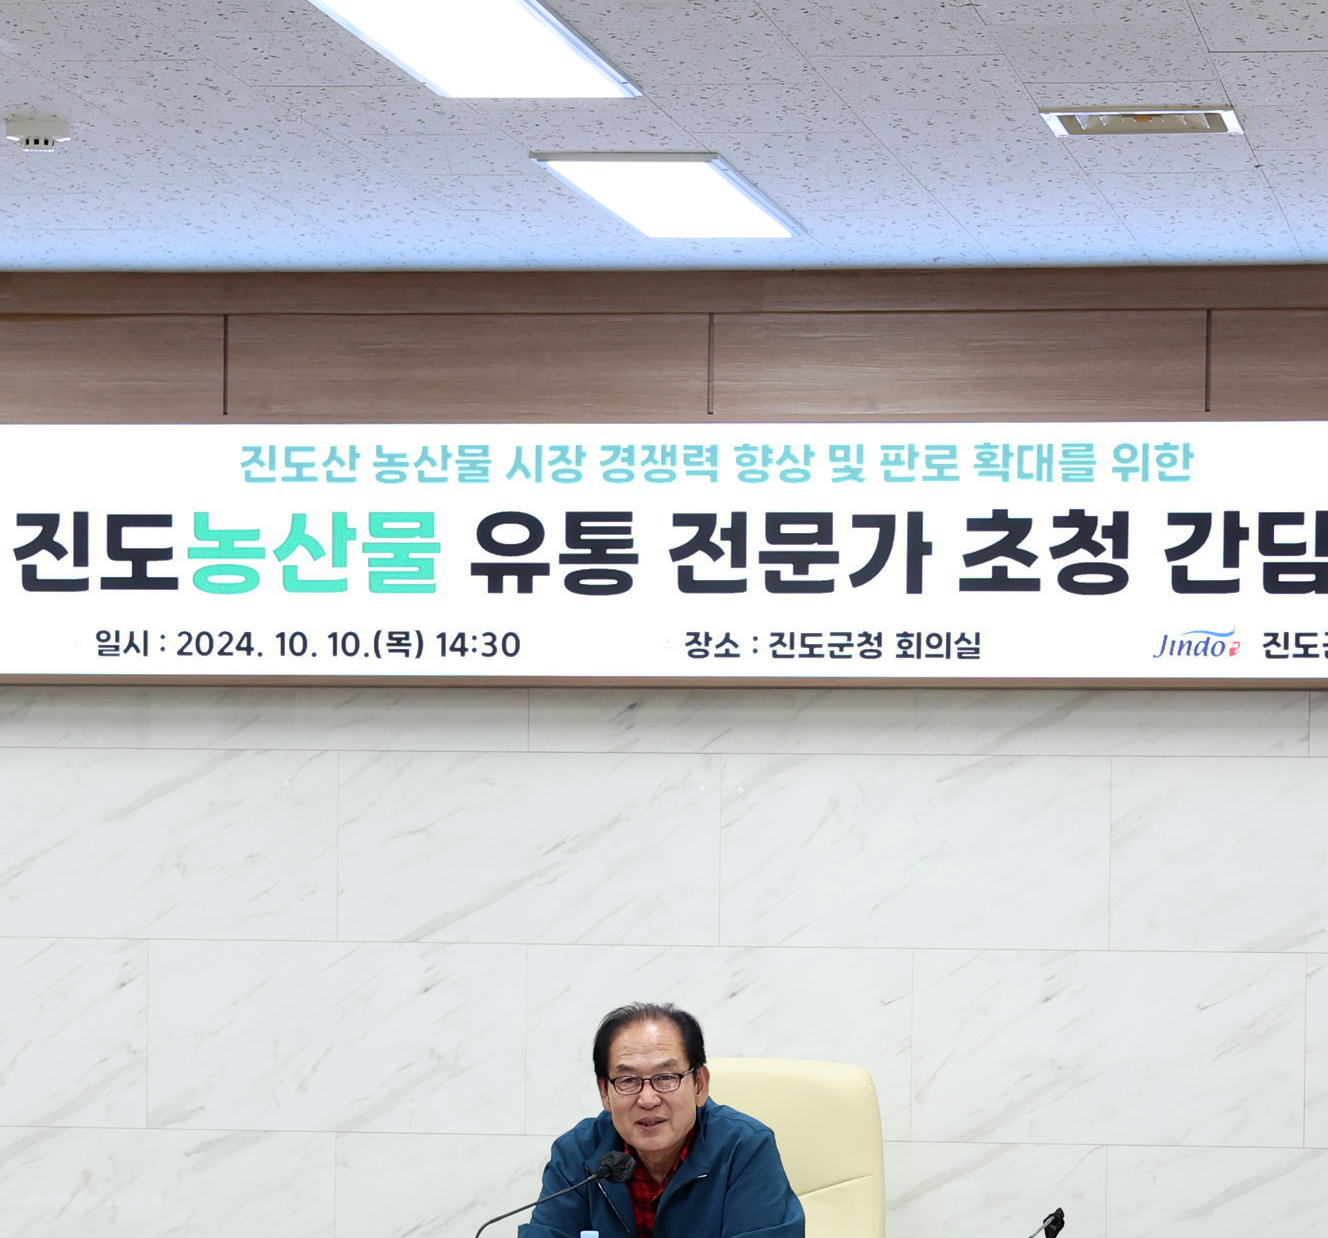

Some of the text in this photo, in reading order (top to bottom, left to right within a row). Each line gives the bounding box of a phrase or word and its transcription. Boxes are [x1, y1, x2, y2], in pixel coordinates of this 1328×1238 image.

[241, 442, 1194, 484] 진도산 농산물 시장 경쟁력 향상 및 판로 확대를 위한
[13, 510, 441, 596] 진도농산물
[470, 510, 639, 596] 유통
[669, 510, 933, 595] 전문가
[959, 509, 1129, 596] 초청
[96, 629, 148, 657] 일시
[177, 631, 263, 657] 2024.
[275, 631, 317, 657] 10.
[328, 630, 424, 659] 10.(목)
[436, 631, 520, 657] 14:30
[685, 631, 740, 659] 장소
[769, 631, 882, 659] 진도군청
[896, 631, 980, 660] 회의실
